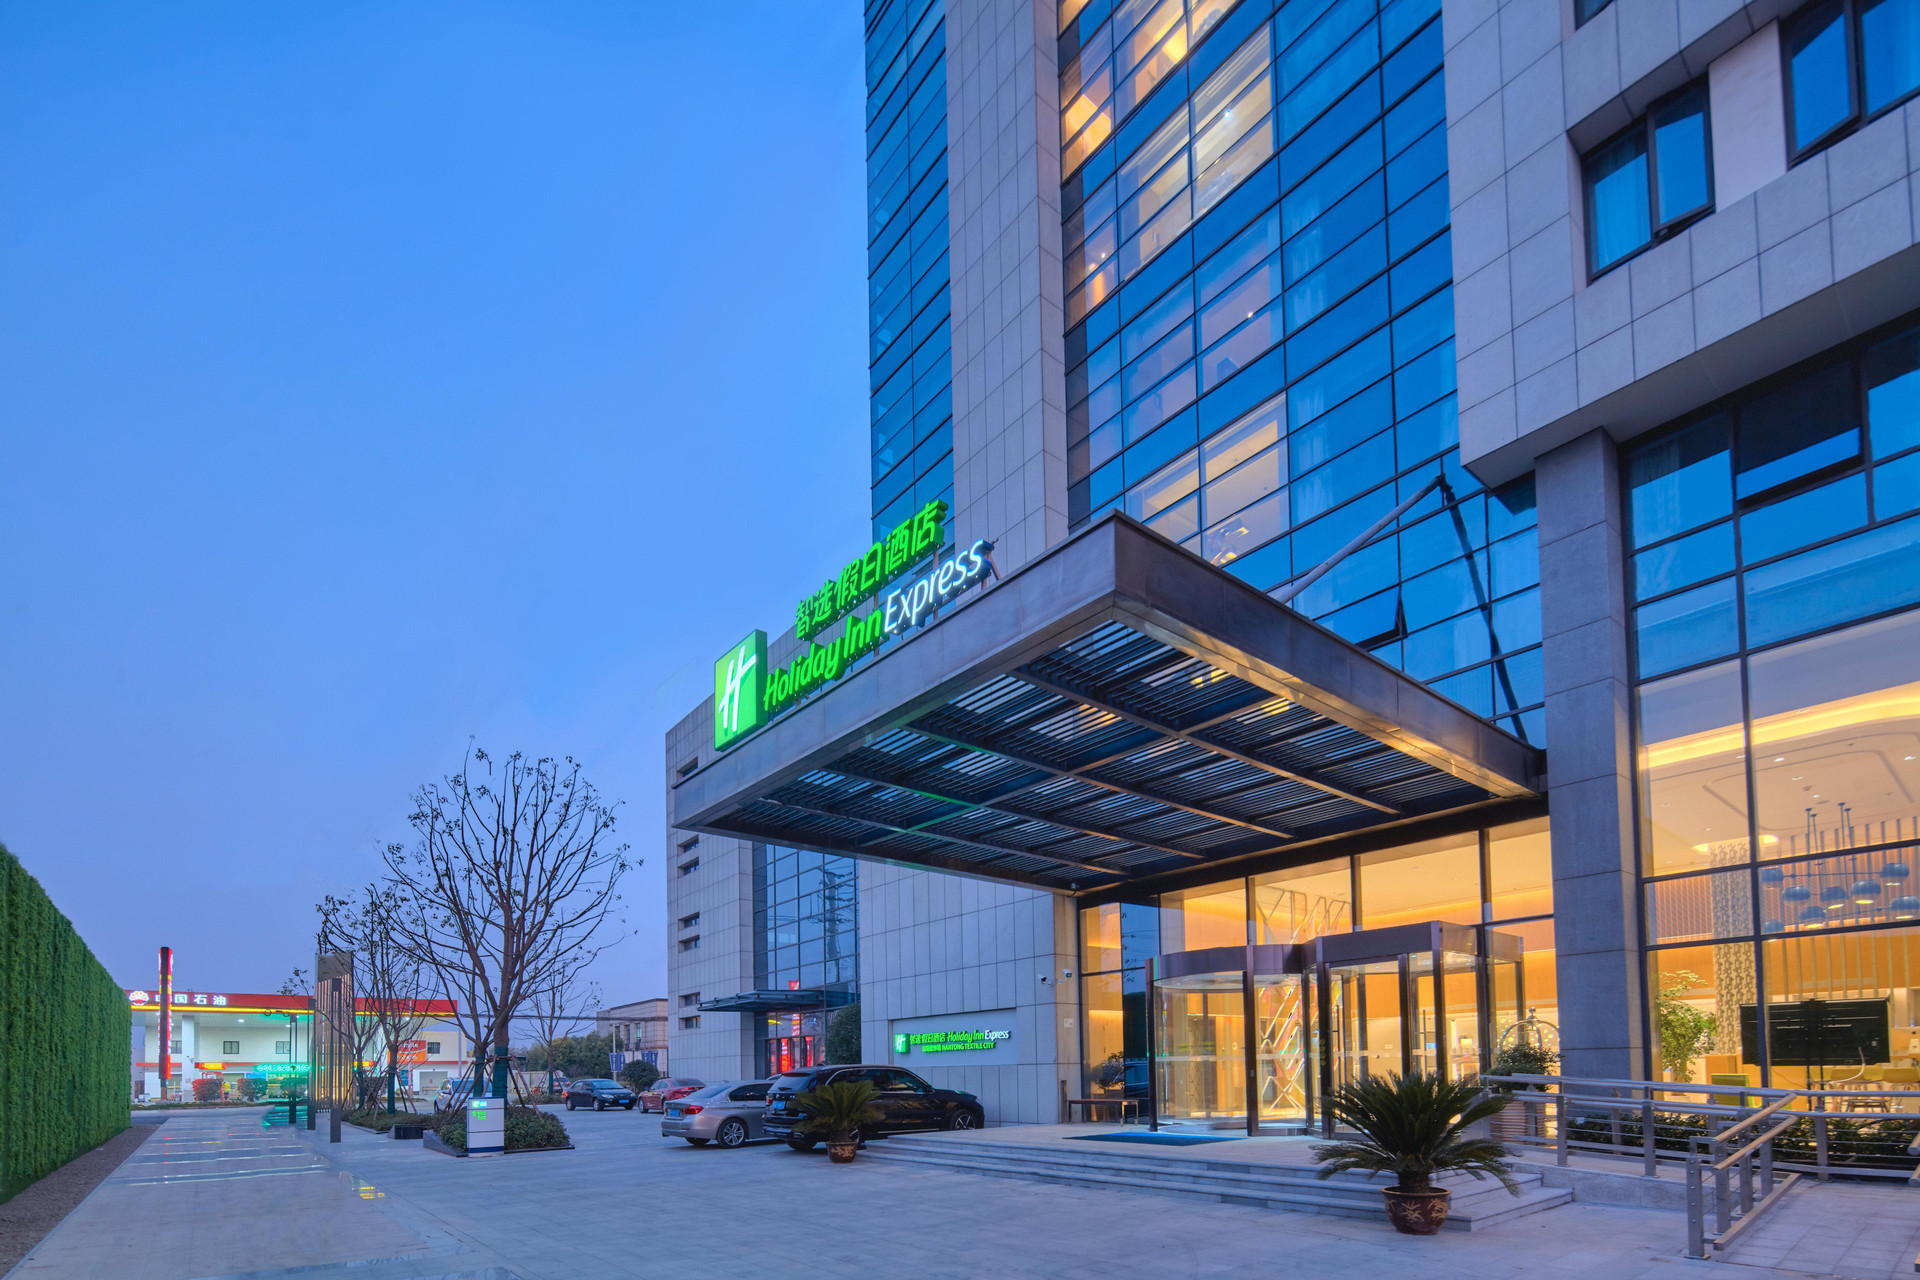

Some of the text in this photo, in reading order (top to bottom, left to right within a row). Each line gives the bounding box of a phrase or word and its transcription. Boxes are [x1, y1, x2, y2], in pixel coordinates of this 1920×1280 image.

[764, 539, 988, 711] Holiday Inn Express
[795, 499, 946, 640] 智选假日酒店
[947, 1030, 1010, 1043] Holiday Inn Express
